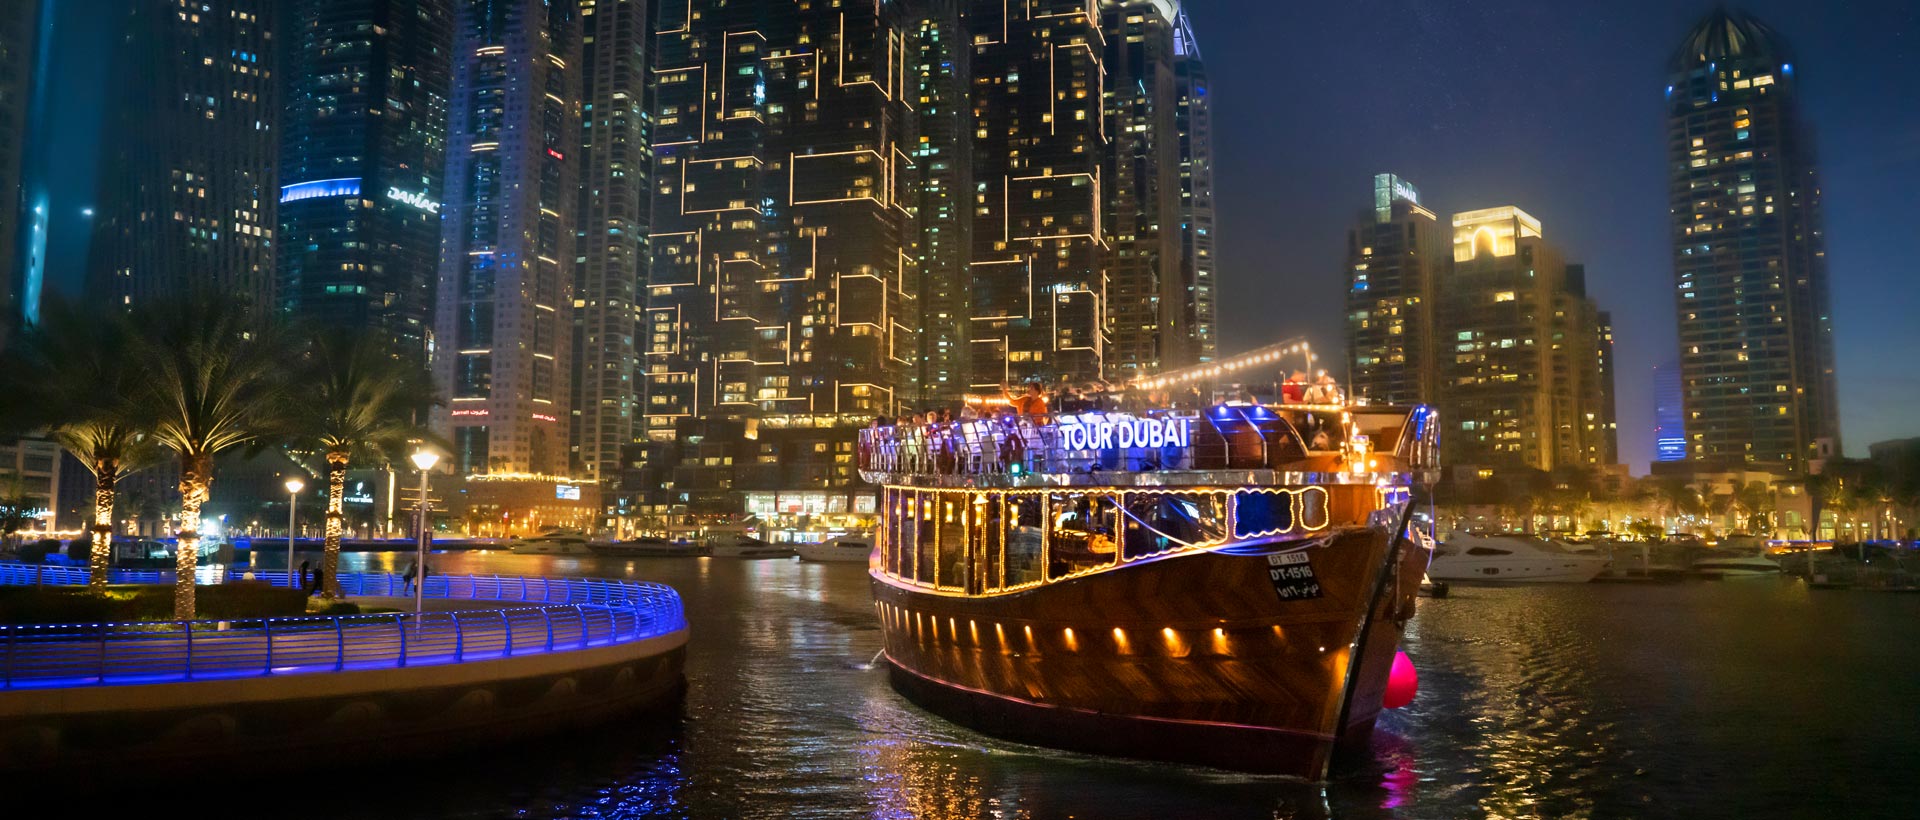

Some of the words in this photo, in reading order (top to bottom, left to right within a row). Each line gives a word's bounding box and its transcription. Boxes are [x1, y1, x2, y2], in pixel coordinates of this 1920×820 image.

[387, 186, 440, 214] DAMAC
[1059, 421, 1113, 451] TOUR
[1118, 418, 1187, 449] DUBAI
[1270, 555, 1282, 565] DT
[1286, 553, 1306, 563] 1516
[1269, 565, 1313, 581] DT-1516
